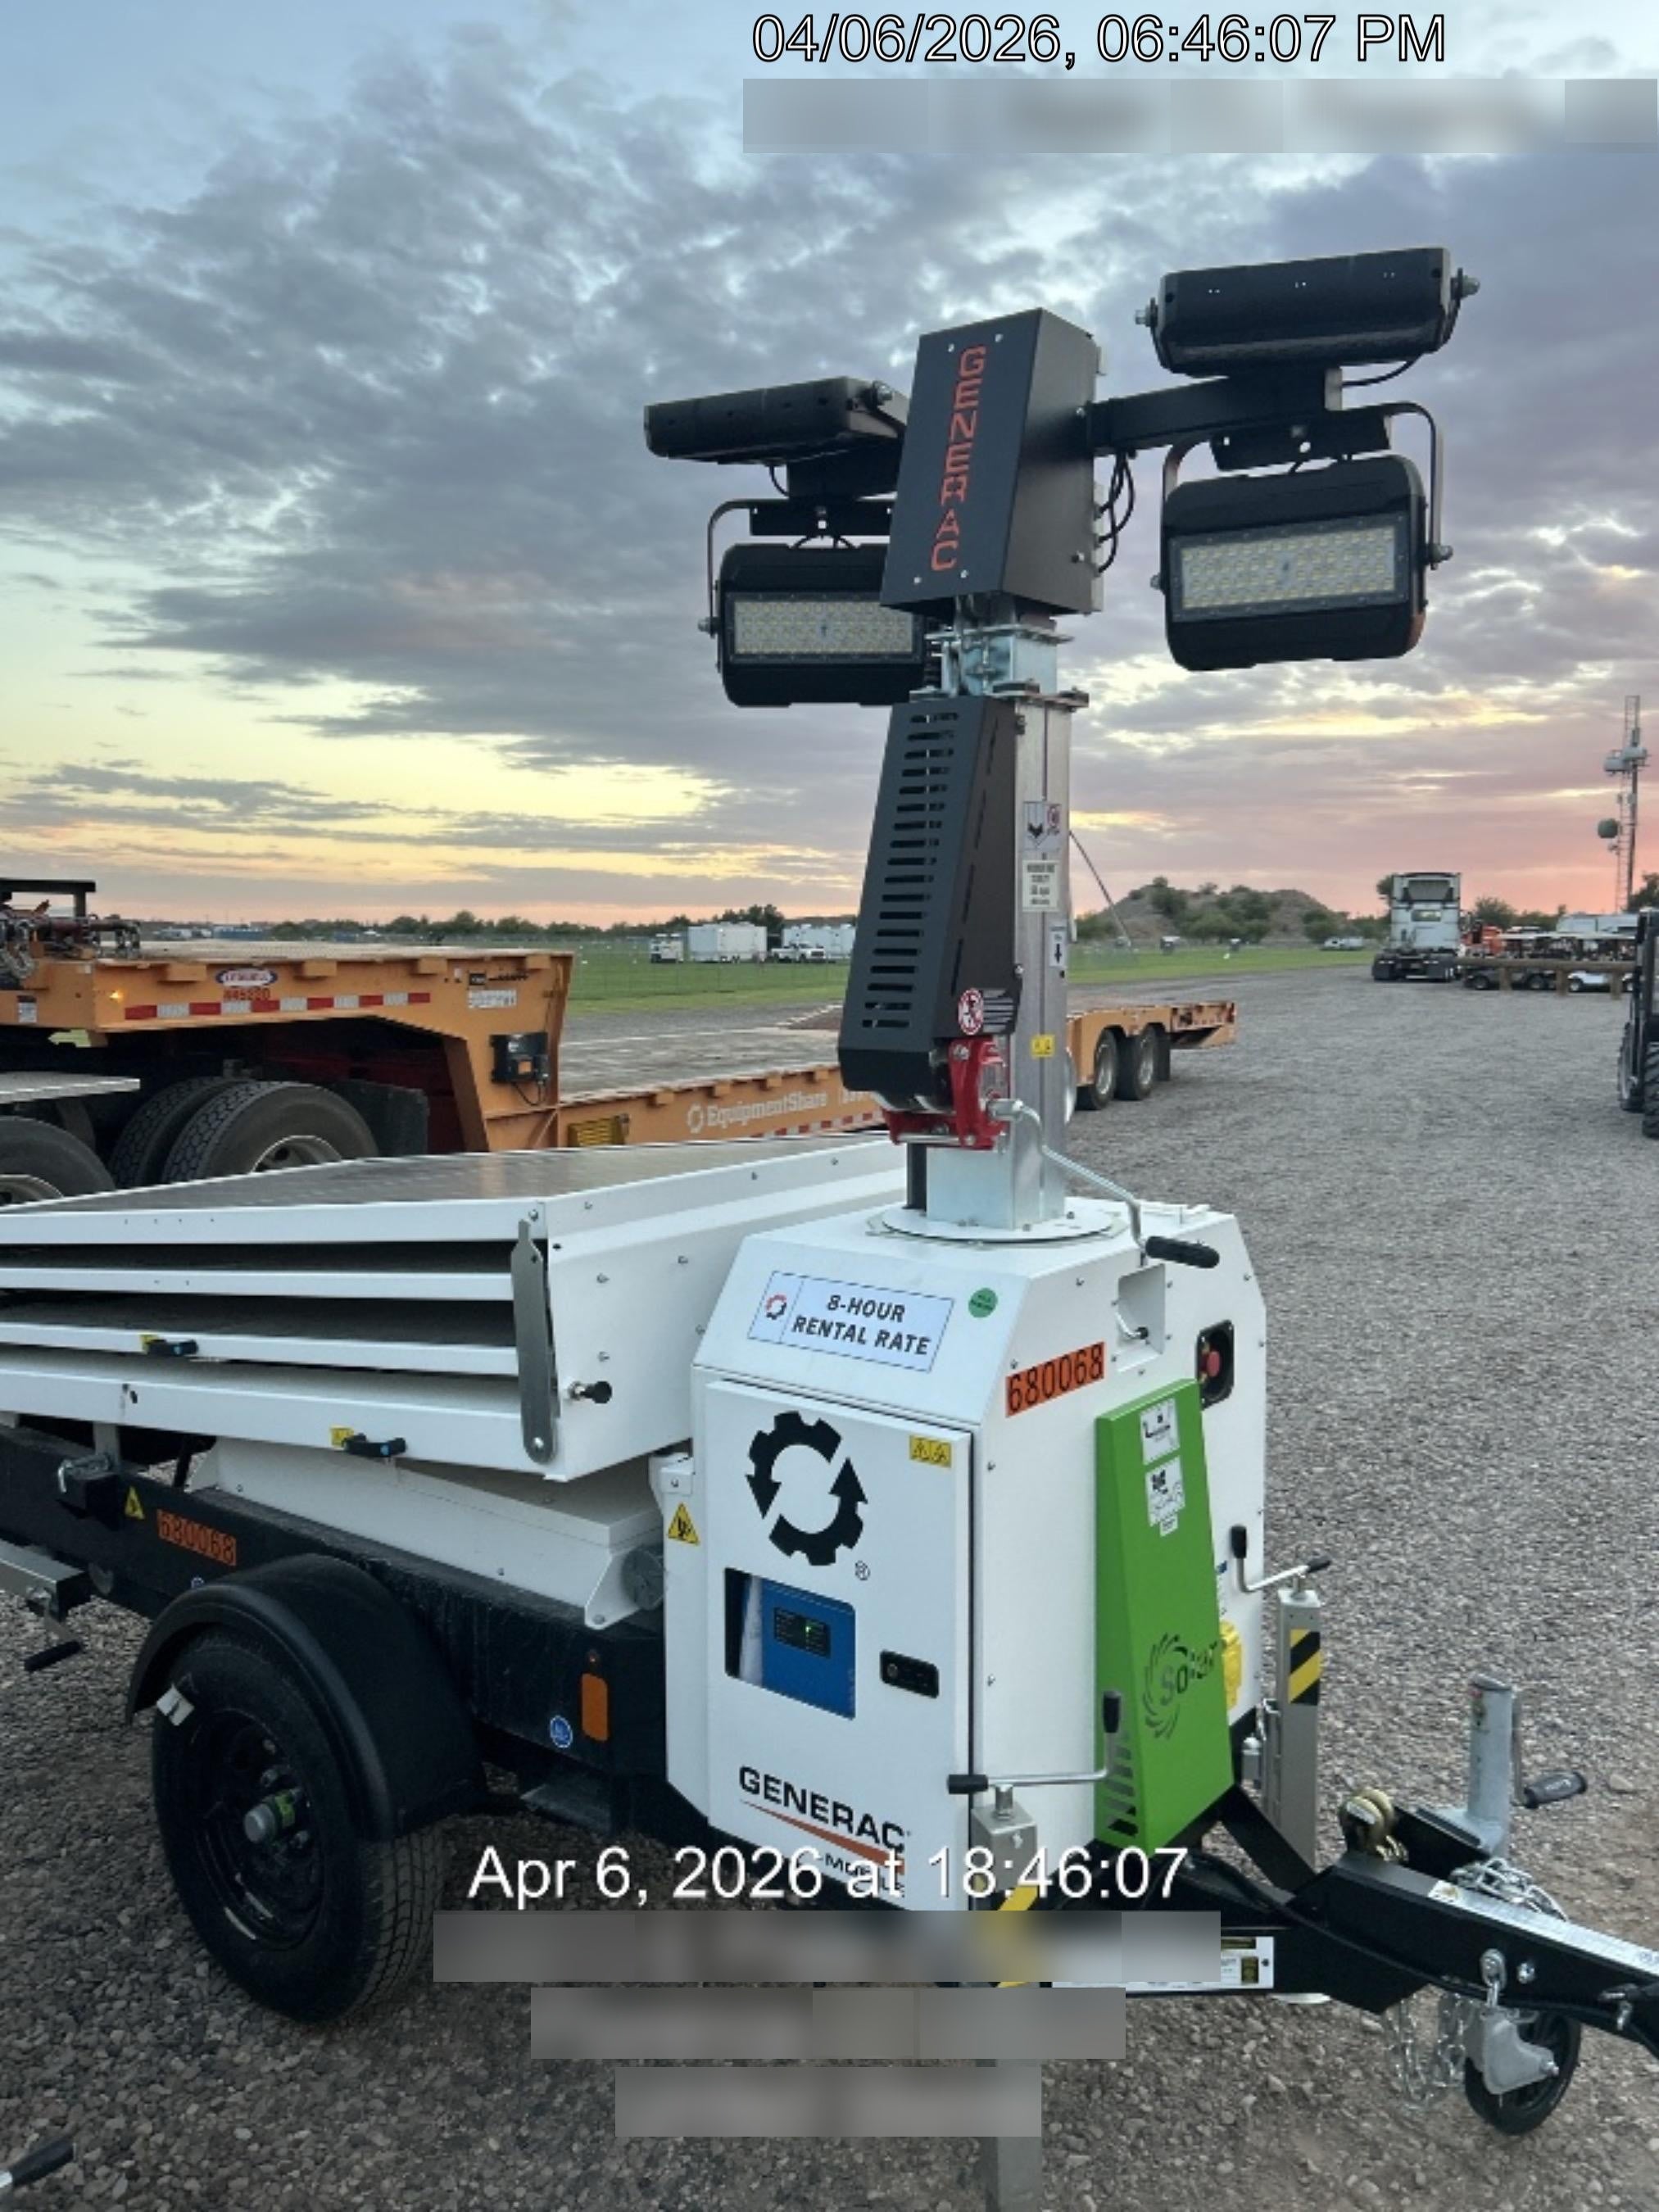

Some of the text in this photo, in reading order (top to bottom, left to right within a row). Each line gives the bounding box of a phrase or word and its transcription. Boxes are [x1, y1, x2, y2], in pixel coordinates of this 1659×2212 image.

[930, 343, 988, 572] GENERAC
[707, 1092, 827, 1128] EquipmentShare
[791, 1314, 931, 1355] RENTAL RATE
[827, 1294, 905, 1323] 8-HOUR
[1008, 1344, 1103, 1413] 680068
[161, 1512, 234, 1565] 680068
[738, 1766, 904, 1852] GENERAC
